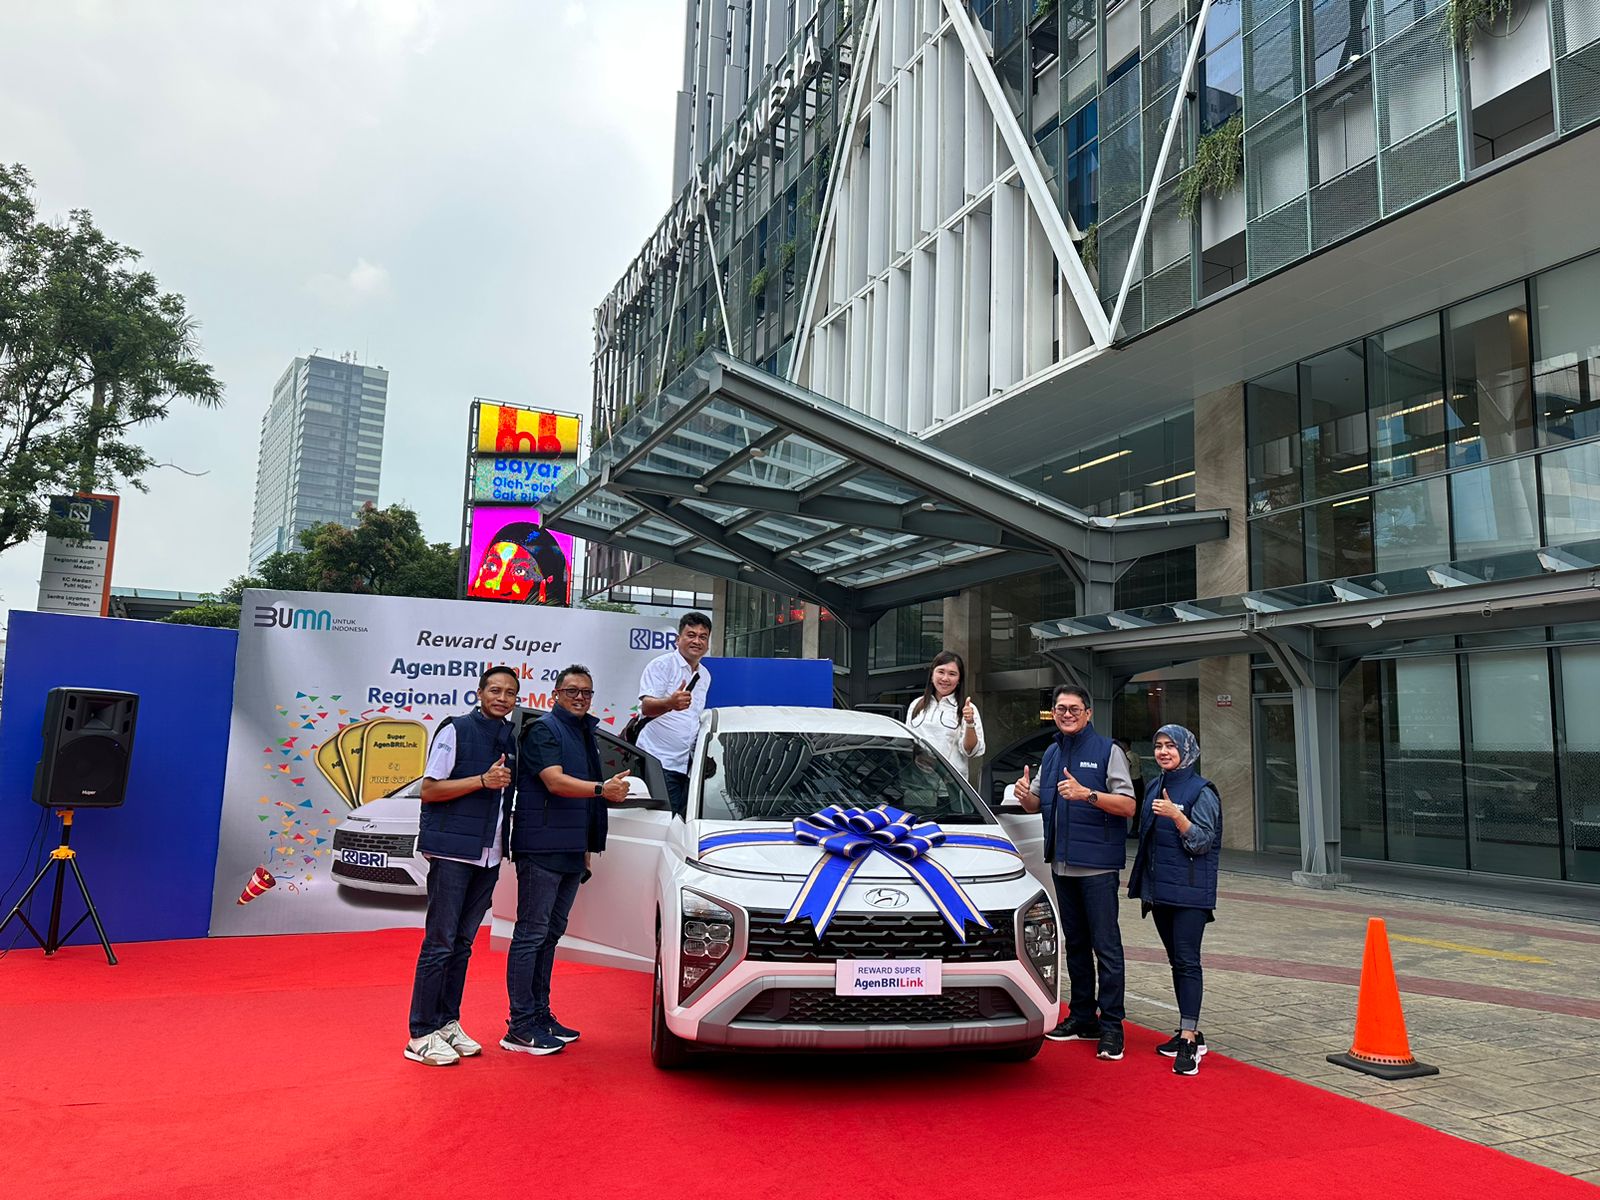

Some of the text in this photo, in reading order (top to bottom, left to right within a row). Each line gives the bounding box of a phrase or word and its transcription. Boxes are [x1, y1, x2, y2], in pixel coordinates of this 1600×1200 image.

[708, 34, 822, 201] INDONESIA
[494, 457, 562, 481] Bayar
[331, 625, 369, 633] INDONESIA
[416, 630, 562, 656] Reward Super
[652, 631, 678, 650] BR
[390, 658, 534, 680] AgenBRInk
[367, 687, 457, 708] Regional
[373, 741, 418, 749] AgenBRILink
[386, 733, 406, 741] Super
[358, 852, 385, 867] BRI
[857, 966, 921, 975] REWARD SUPER
[854, 977, 924, 990] AgenBRILink
